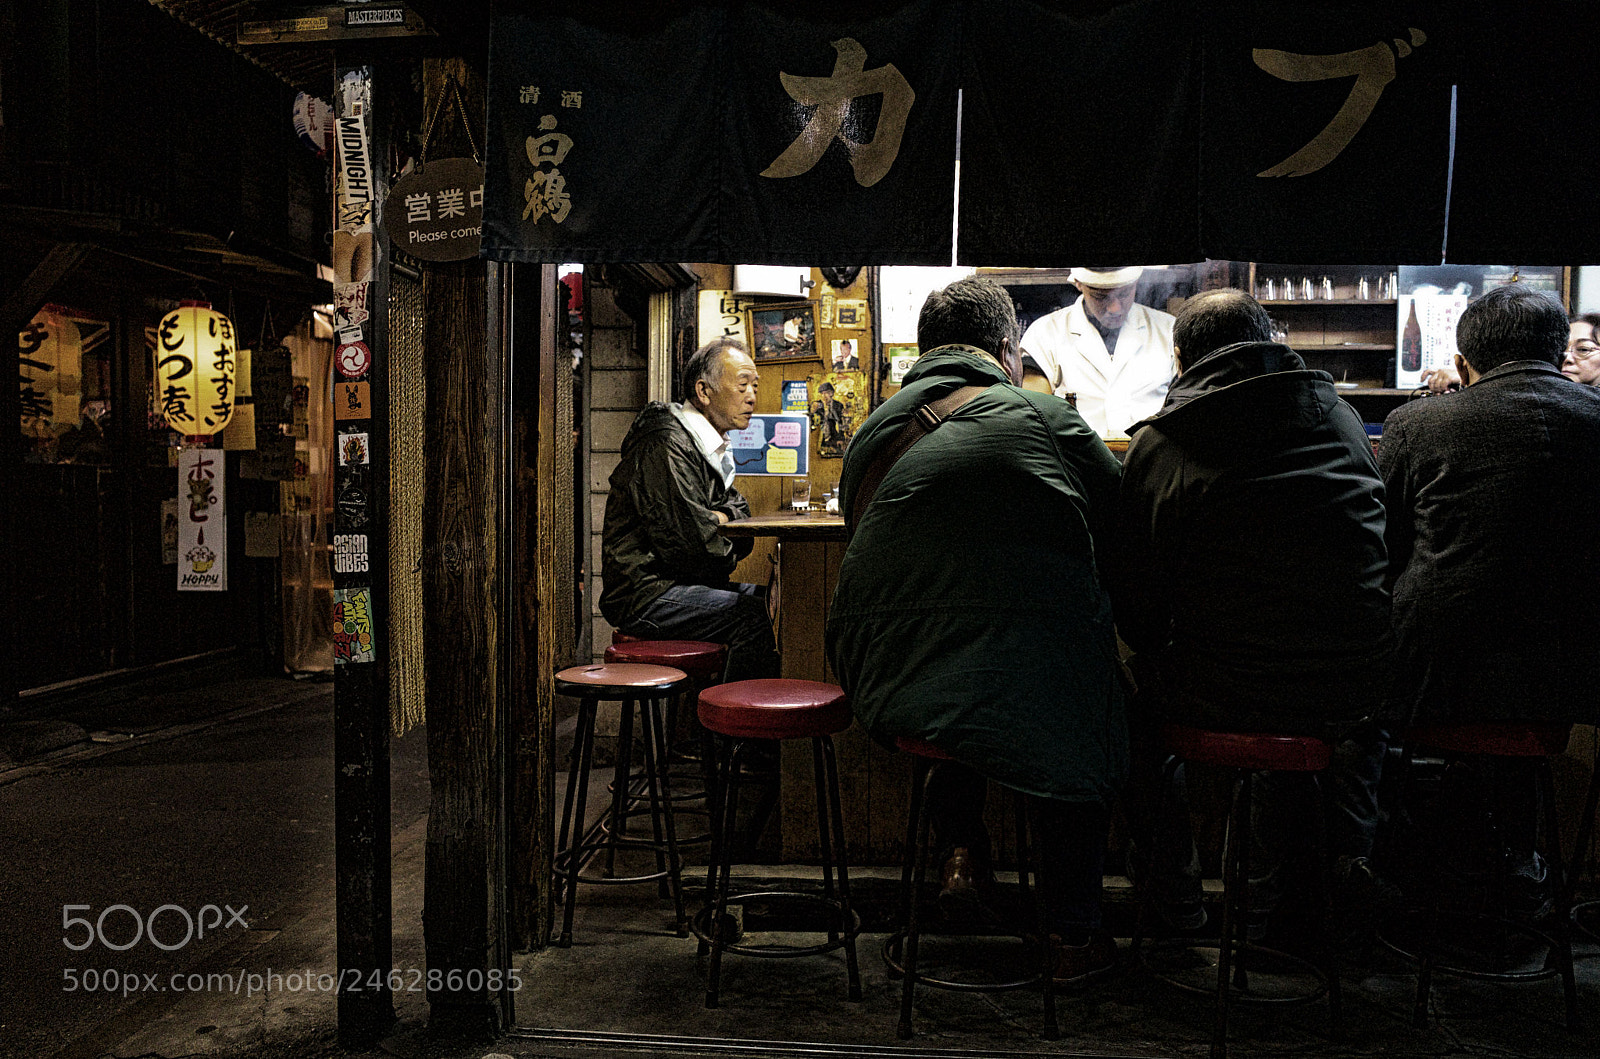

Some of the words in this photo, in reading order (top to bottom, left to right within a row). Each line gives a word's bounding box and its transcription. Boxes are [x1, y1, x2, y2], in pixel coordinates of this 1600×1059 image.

[347, 9, 404, 24] MASTERPIECES
[339, 118, 371, 202] MIDNIGHT
[521, 114, 576, 225] 白鶴
[409, 228, 448, 244] Please
[450, 226, 482, 240] come
